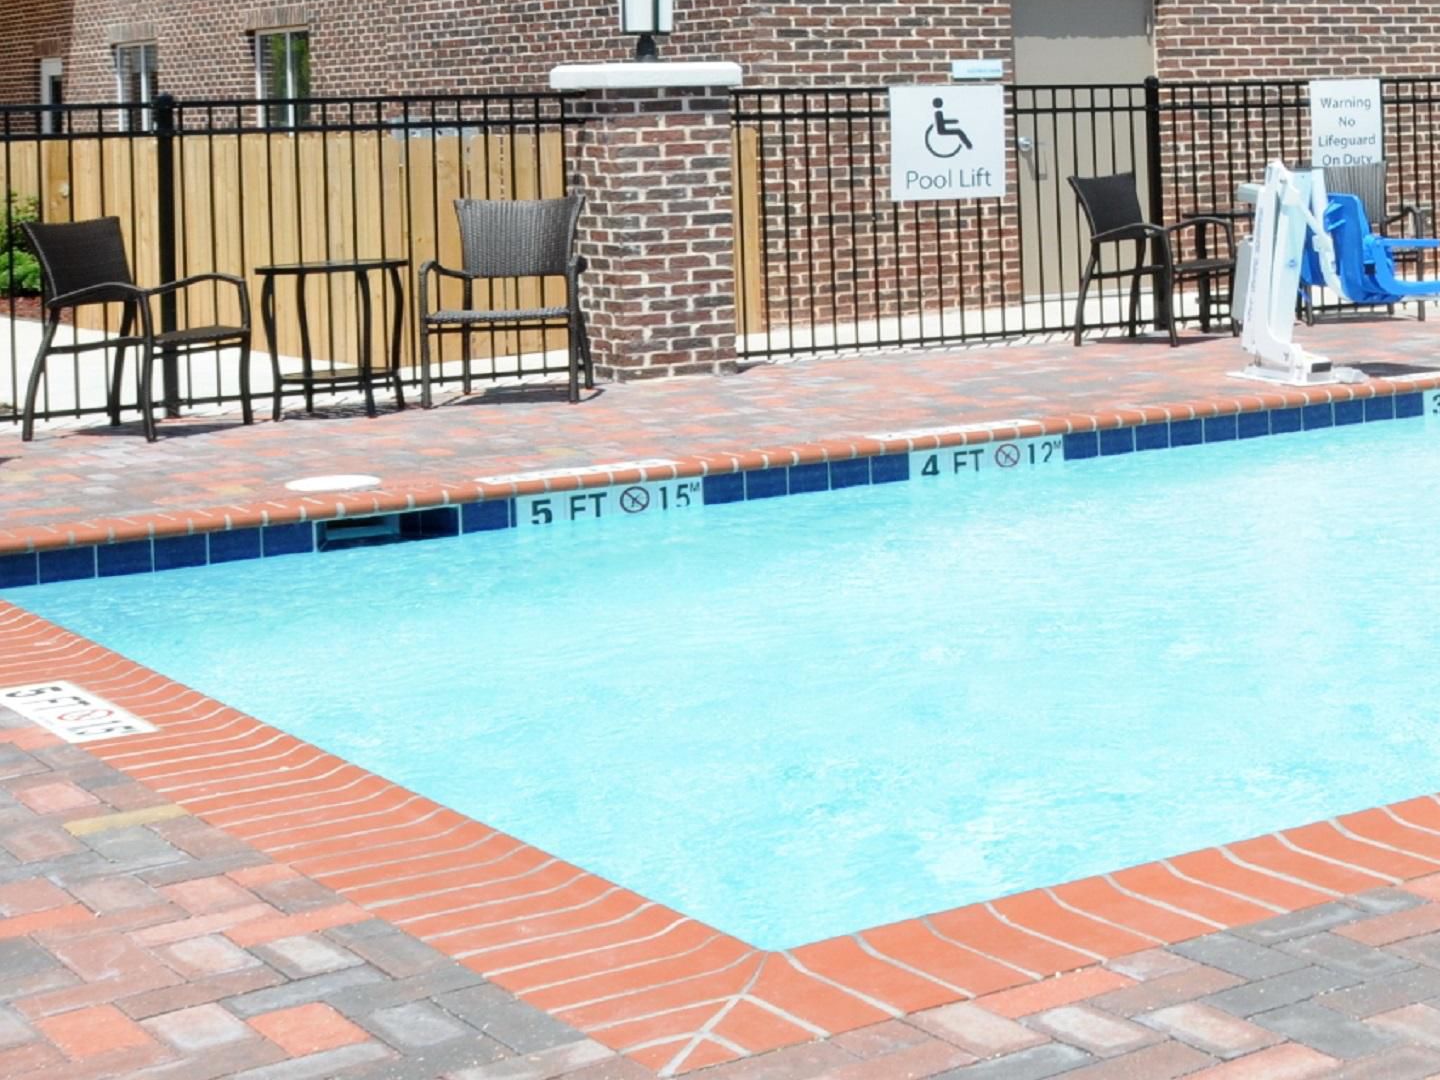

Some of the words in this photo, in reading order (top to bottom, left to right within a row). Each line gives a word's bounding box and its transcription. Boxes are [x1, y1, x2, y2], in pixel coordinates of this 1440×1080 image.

[1320, 96, 1372, 111] Warning
[1338, 116, 1356, 127] No
[1318, 133, 1376, 149] Lifeguard
[1322, 154, 1341, 167] On
[1343, 153, 1373, 166] Duty
[905, 168, 953, 190] Pool
[959, 166, 992, 188] Lift
[920, 453, 941, 477] 4
[952, 448, 985, 474] FT
[530, 498, 553, 526] 5
[569, 491, 608, 521] FT
